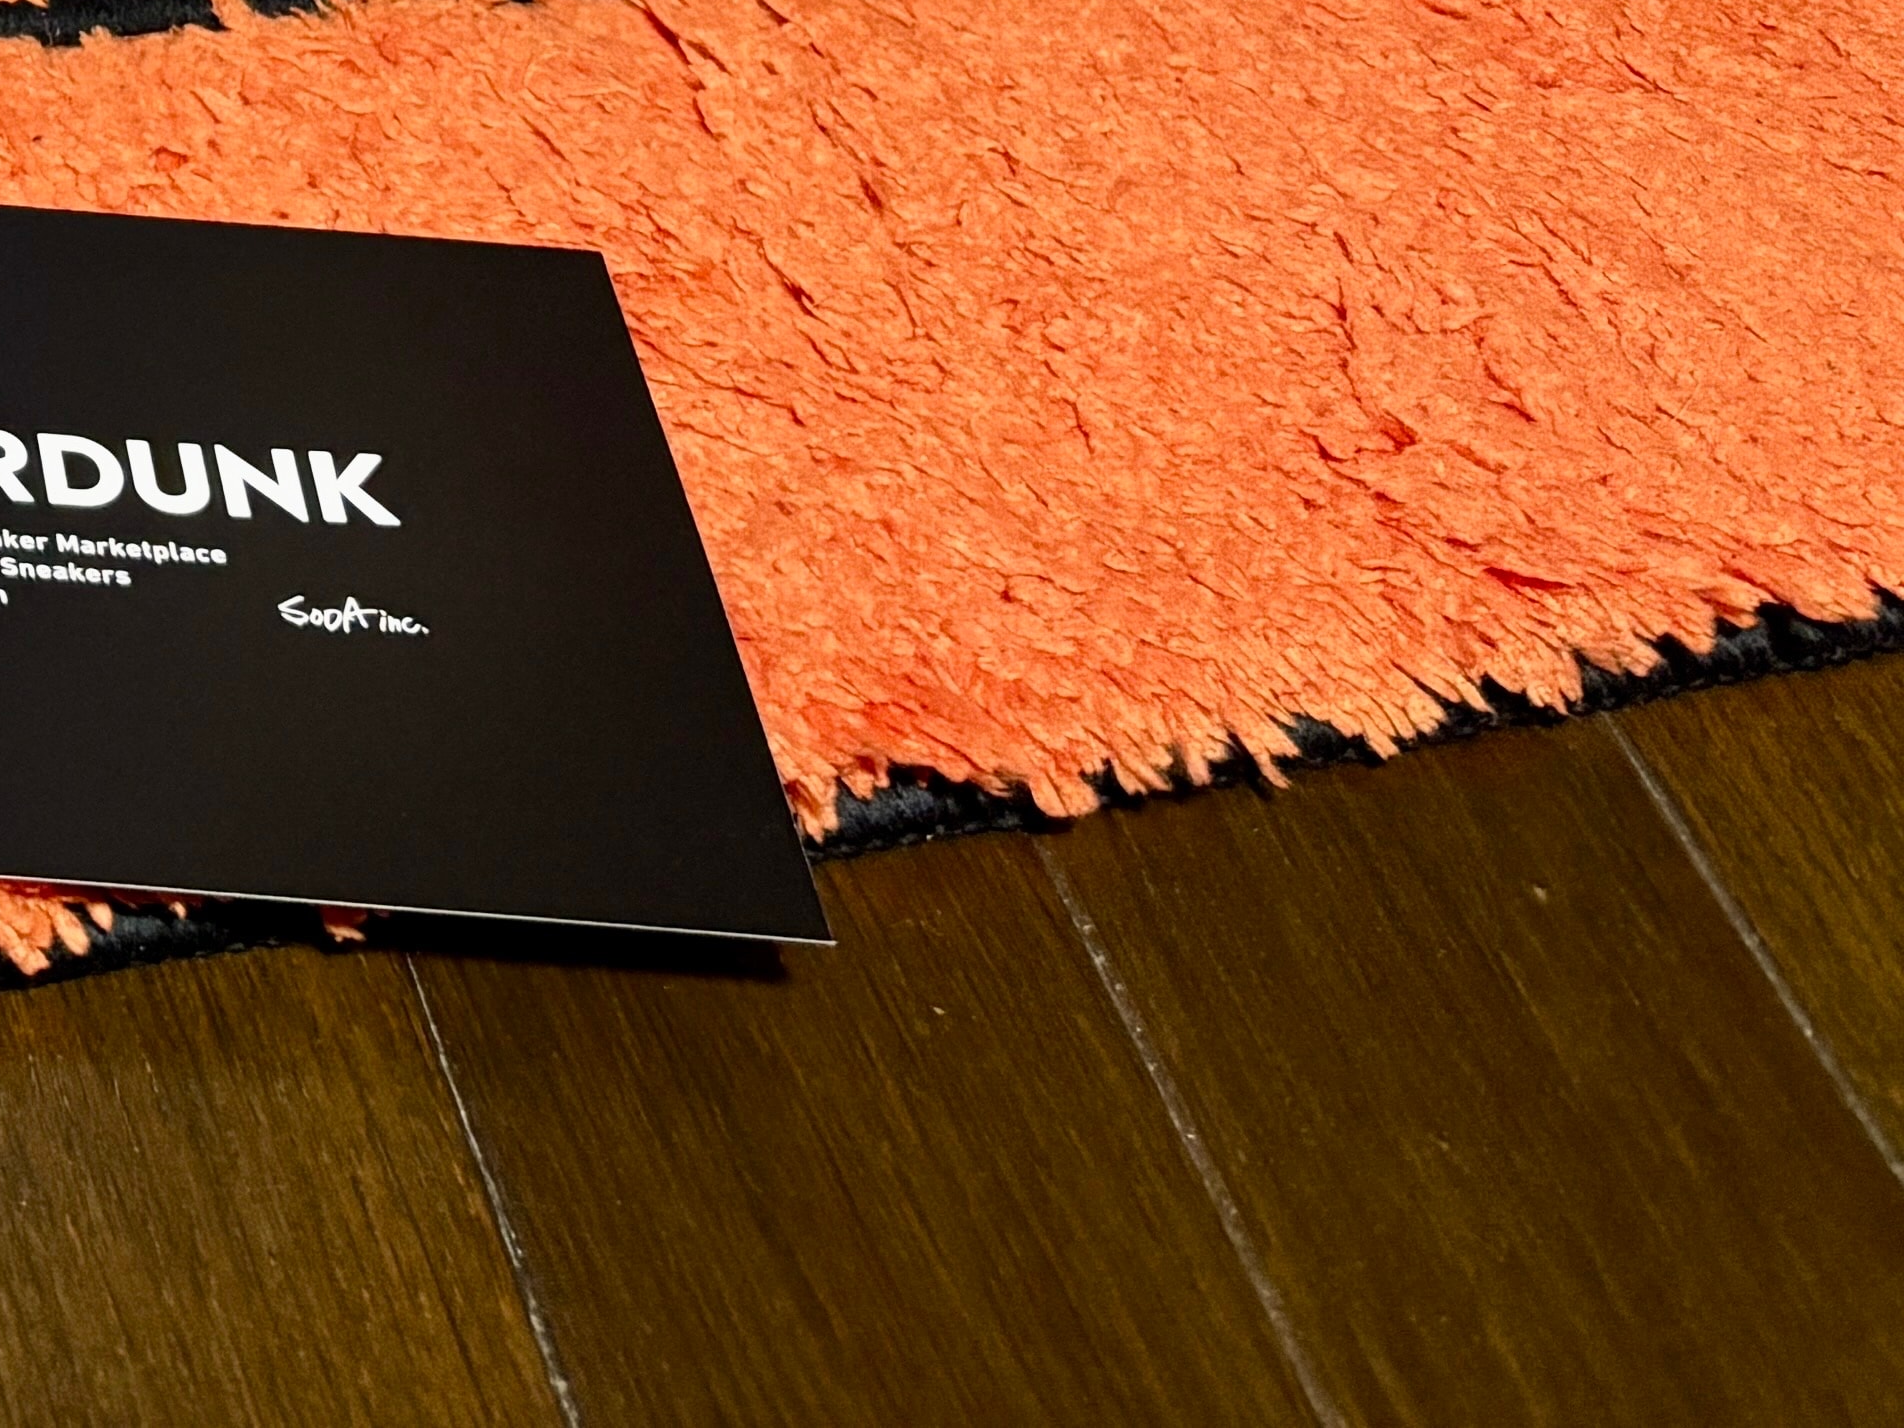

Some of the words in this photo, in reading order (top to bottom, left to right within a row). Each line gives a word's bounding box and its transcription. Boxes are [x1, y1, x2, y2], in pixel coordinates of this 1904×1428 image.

[55, 532, 228, 565] Marketplace
[0, 556, 133, 586] Sneakers
[378, 609, 430, 634] inc.
